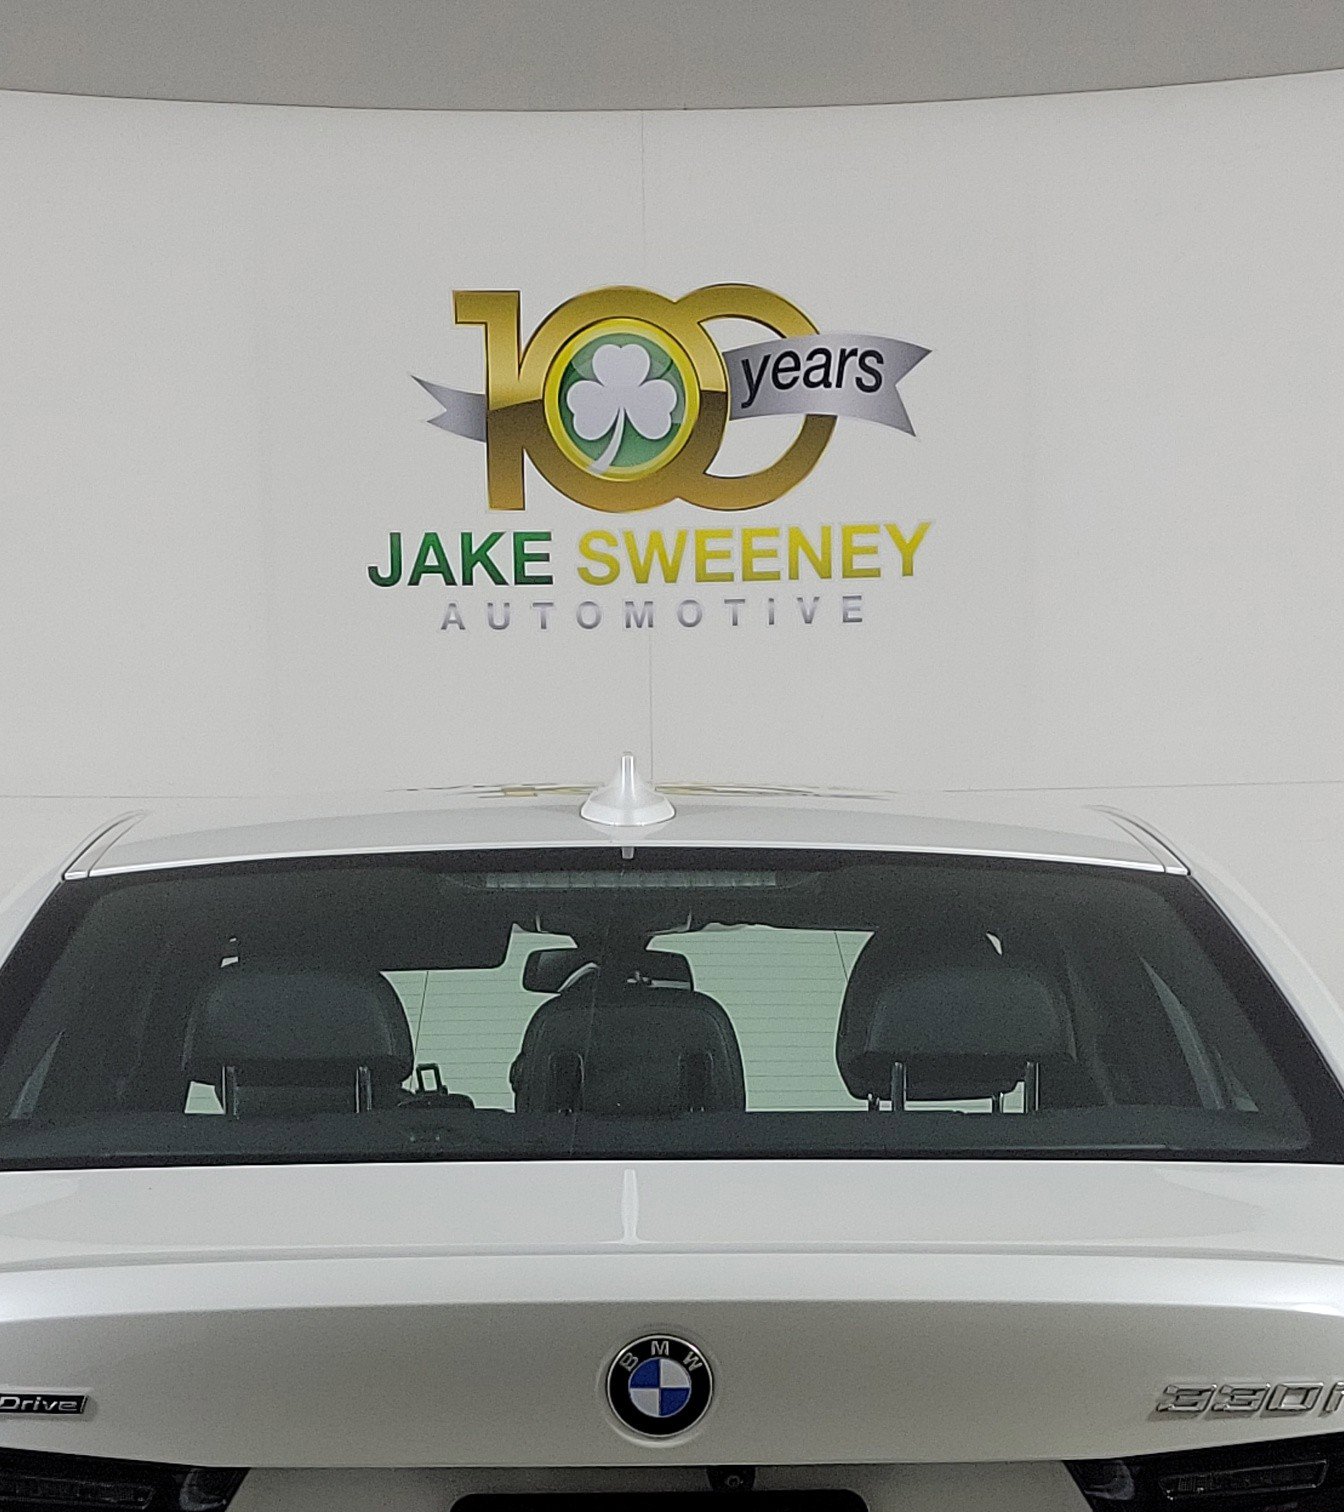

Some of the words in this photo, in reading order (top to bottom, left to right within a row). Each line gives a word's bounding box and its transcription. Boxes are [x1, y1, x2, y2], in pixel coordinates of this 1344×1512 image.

[452, 283, 838, 513] 100
[740, 346, 885, 409] years
[368, 530, 554, 587] JAKE
[577, 521, 932, 584] SWEENEY
[440, 594, 864, 631] AUTOMOTIVE
[619, 1340, 703, 1372] BMW
